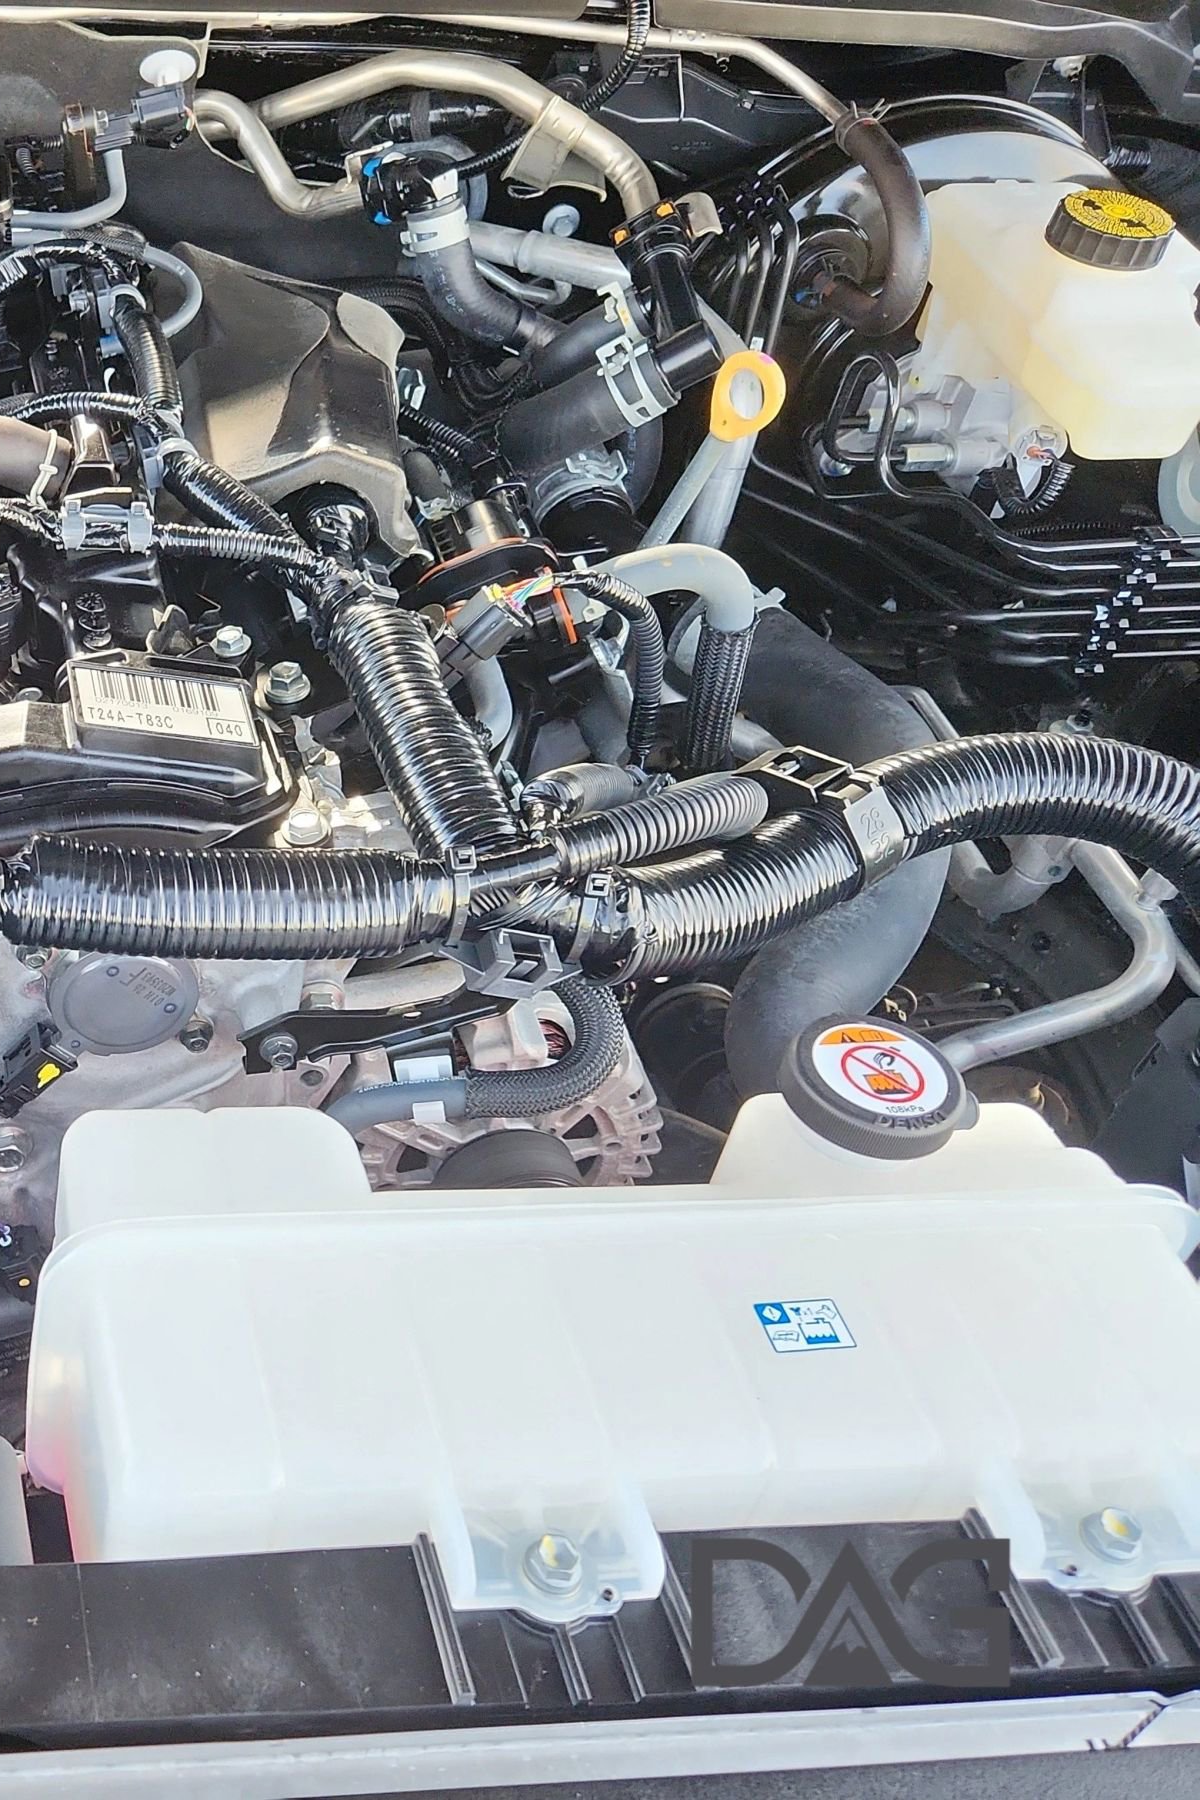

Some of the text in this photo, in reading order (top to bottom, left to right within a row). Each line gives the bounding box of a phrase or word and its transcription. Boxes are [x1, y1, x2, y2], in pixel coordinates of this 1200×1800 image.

[87, 706, 174, 729] T24A-T83C
[214, 722, 244, 737] 040
[860, 806, 885, 839] 28
[877, 1110, 946, 1130] DENSO
